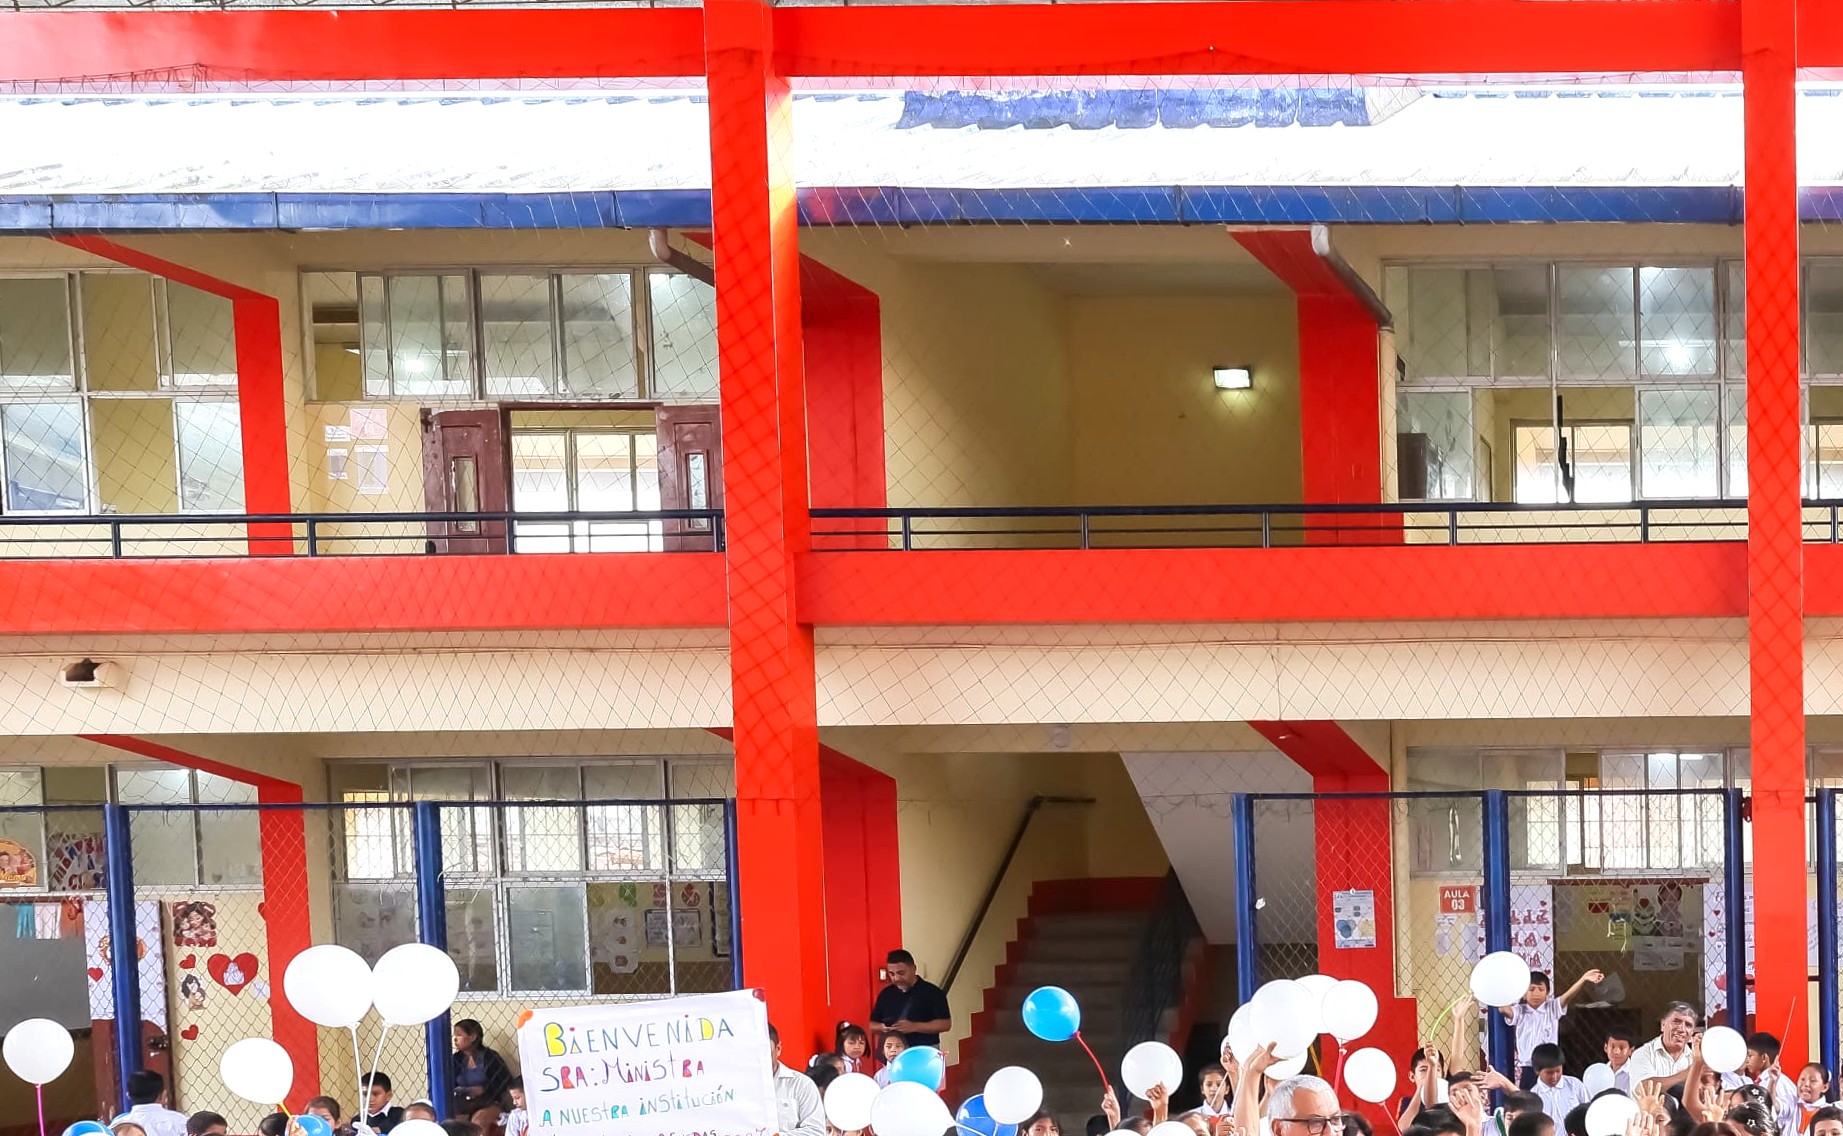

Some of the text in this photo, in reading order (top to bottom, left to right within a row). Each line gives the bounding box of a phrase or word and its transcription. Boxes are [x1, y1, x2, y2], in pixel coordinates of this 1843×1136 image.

[1443, 889, 1471, 899] AULA
[1451, 899, 1465, 911] 03
[539, 1108, 556, 1128] A
